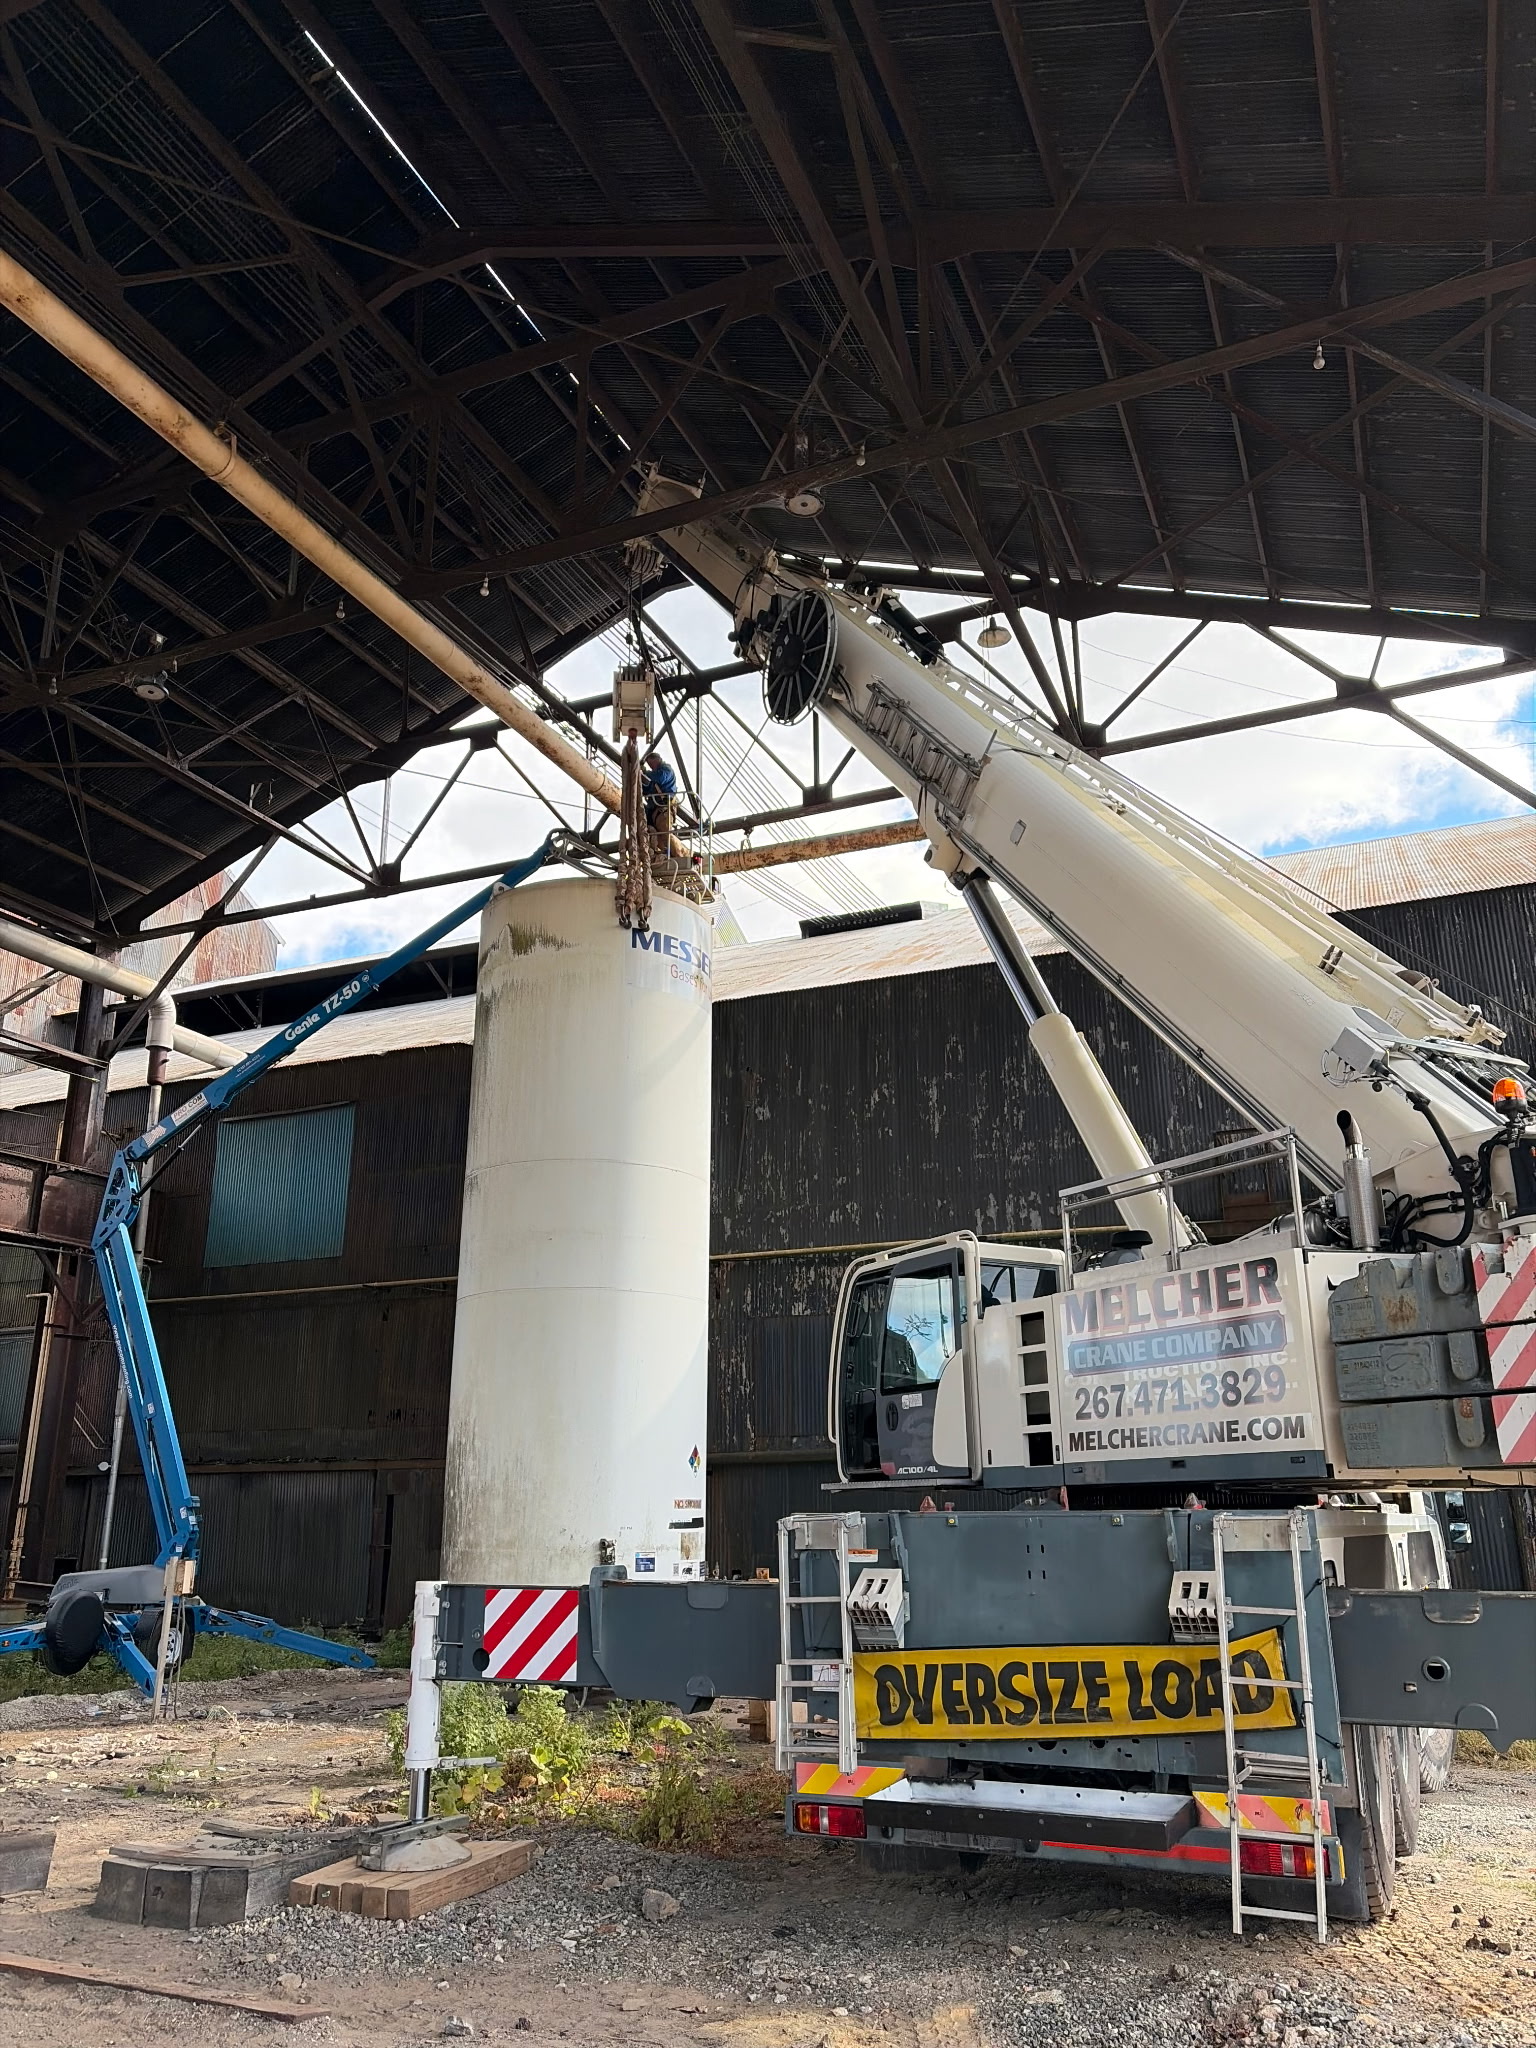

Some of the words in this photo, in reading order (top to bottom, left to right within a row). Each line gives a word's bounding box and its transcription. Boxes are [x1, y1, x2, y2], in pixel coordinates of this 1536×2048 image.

[285, 1013, 321, 1041] Genie
[322, 980, 361, 1014] TZ-50
[173, 1106, 187, 1119] PRO
[188, 1094, 203, 1108] COM
[1064, 1257, 1283, 1336] MELCHER
[1073, 1338, 1147, 1370] CRANE
[1151, 1320, 1277, 1360] COMPANY
[1075, 1364, 1287, 1421] 267.471.3829
[1069, 1415, 1305, 1452] MELCHERCRANE.COM
[897, 1465, 938, 1475] AC100/4L
[873, 1660, 1113, 1726] OVERSIZE
[1124, 1649, 1275, 1720] LOAD
